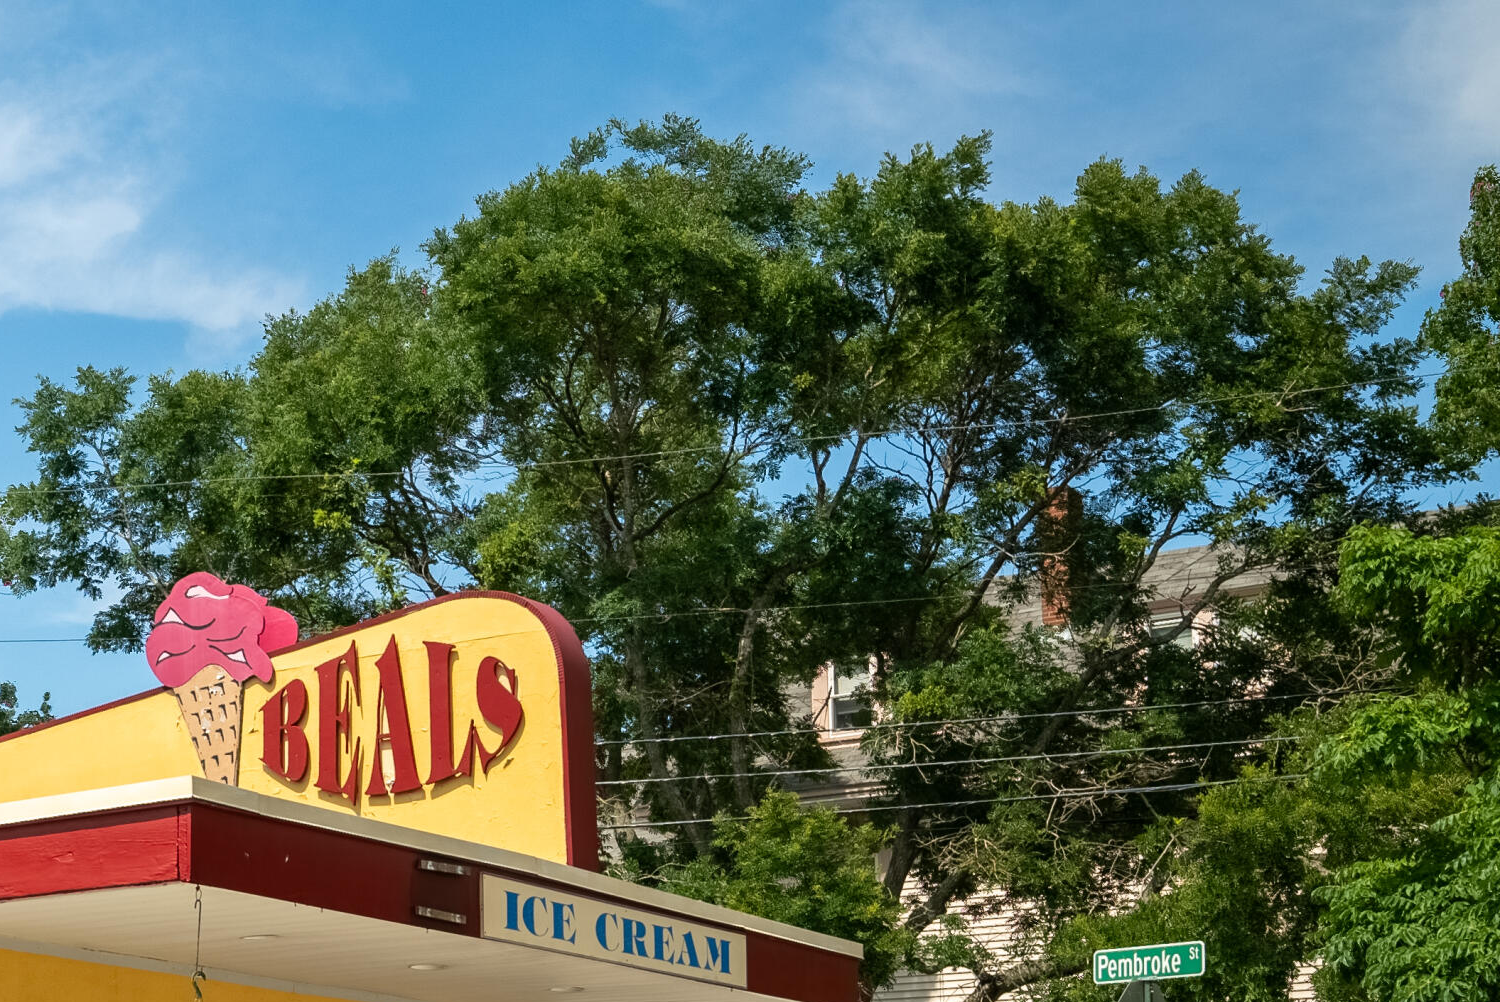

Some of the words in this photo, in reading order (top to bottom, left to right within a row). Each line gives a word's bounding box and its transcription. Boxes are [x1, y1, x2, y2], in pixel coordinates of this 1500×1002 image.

[259, 634, 524, 806] BEALS
[503, 890, 577, 945] ICE
[595, 912, 733, 975] CREAM
[1097, 950, 1182, 979] Pembroke
[1188, 946, 1200, 960] St
